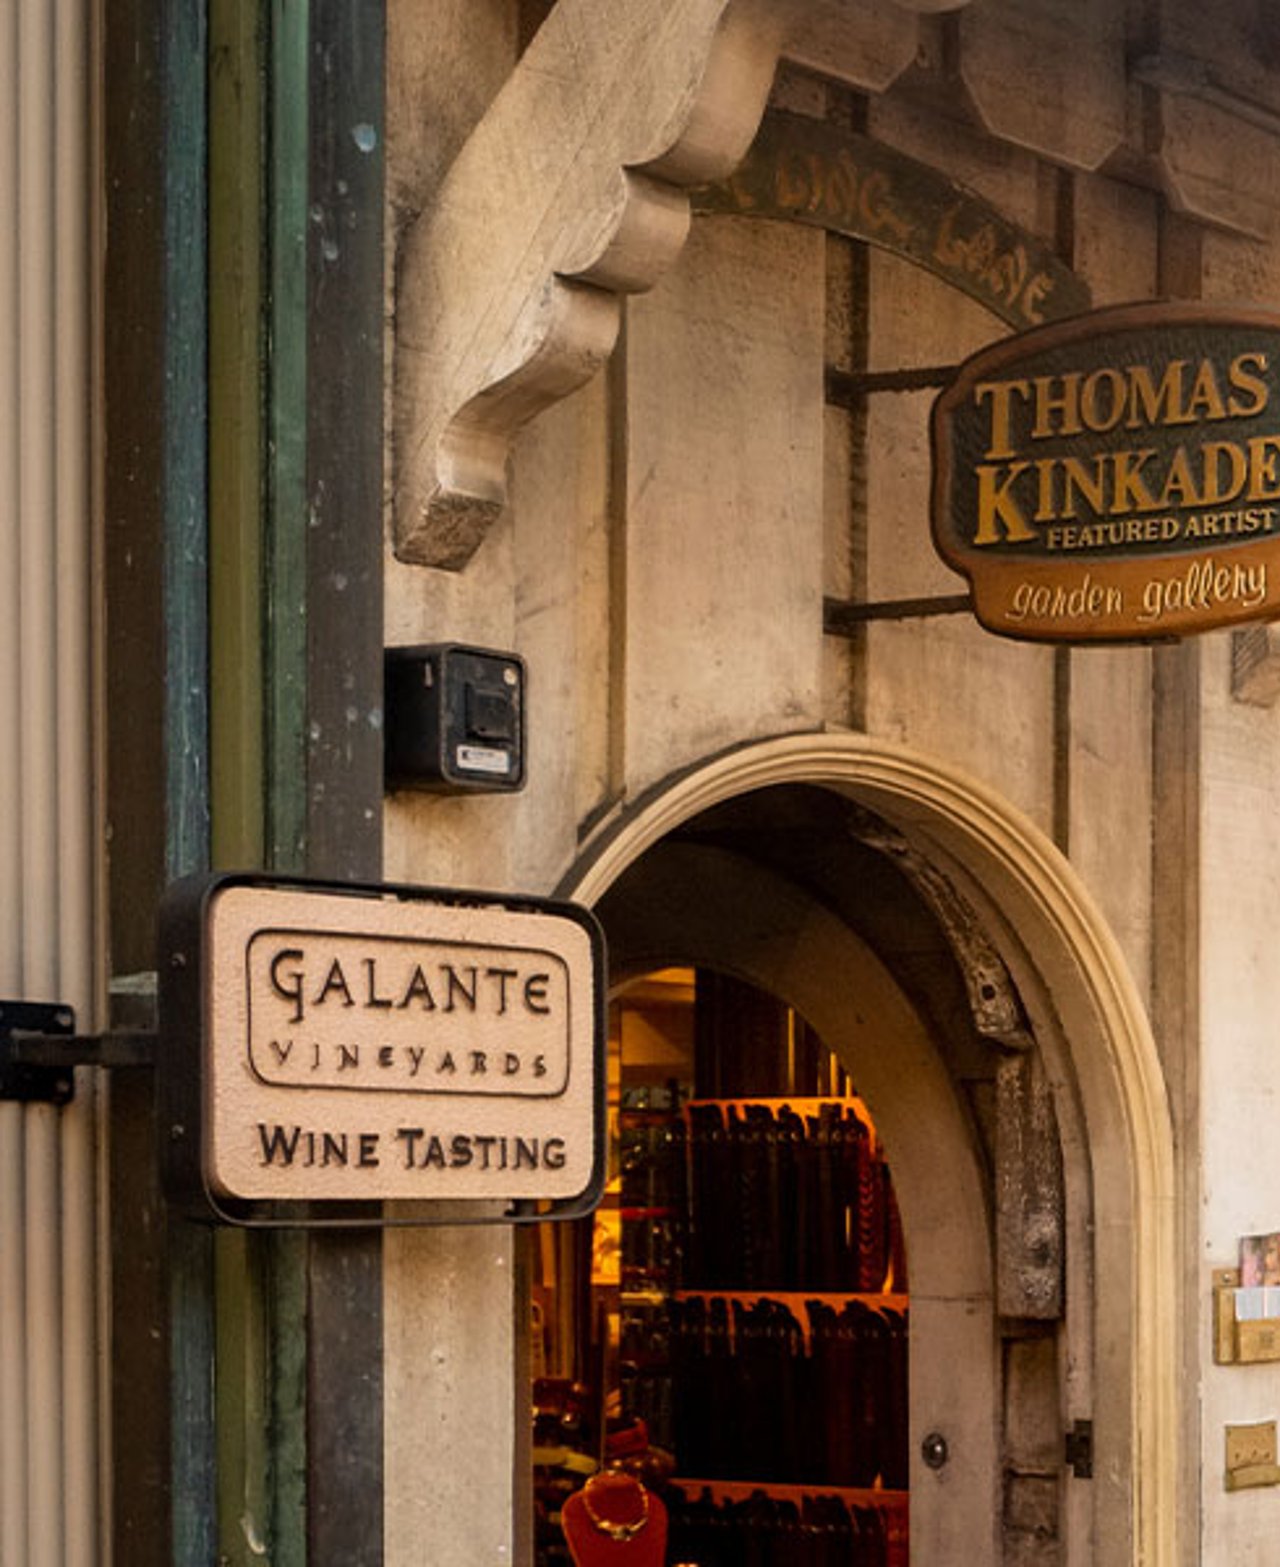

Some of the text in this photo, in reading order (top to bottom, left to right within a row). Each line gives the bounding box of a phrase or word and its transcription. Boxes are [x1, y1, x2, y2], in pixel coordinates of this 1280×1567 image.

[934, 200, 1055, 325] LANE
[975, 352, 1270, 461] THOMAS
[1046, 507, 1278, 550] FEATURED ARTIST
[1005, 559, 1267, 623] garden gallery
[269, 949, 550, 1024] GALANTE
[269, 1040, 547, 1078] VINEYARDS
[257, 1122, 567, 1170] WINE TASTING
